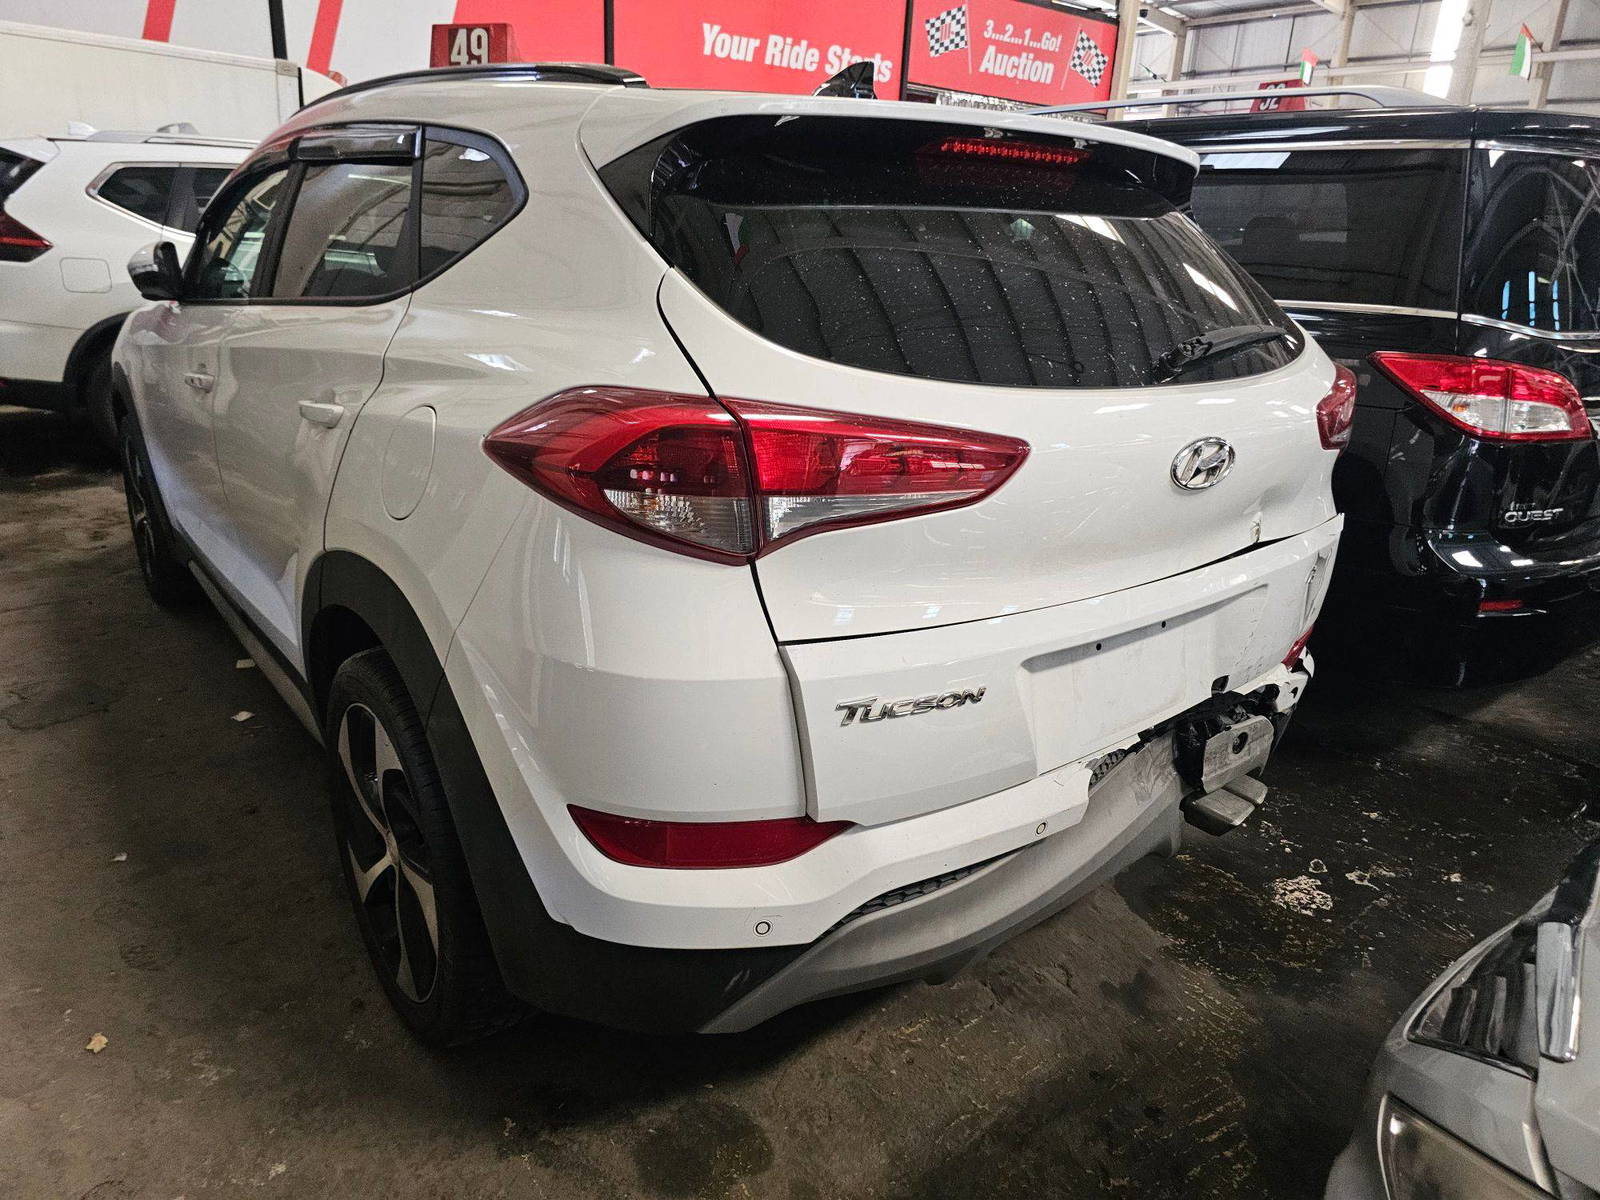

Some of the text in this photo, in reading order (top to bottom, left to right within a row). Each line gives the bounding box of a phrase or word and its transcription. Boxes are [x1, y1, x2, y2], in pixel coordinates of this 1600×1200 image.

[450, 27, 489, 65] 49
[702, 22, 893, 83] Your Ride Stts
[979, 45, 1054, 85] Auction
[835, 686, 987, 727] TUCSON
